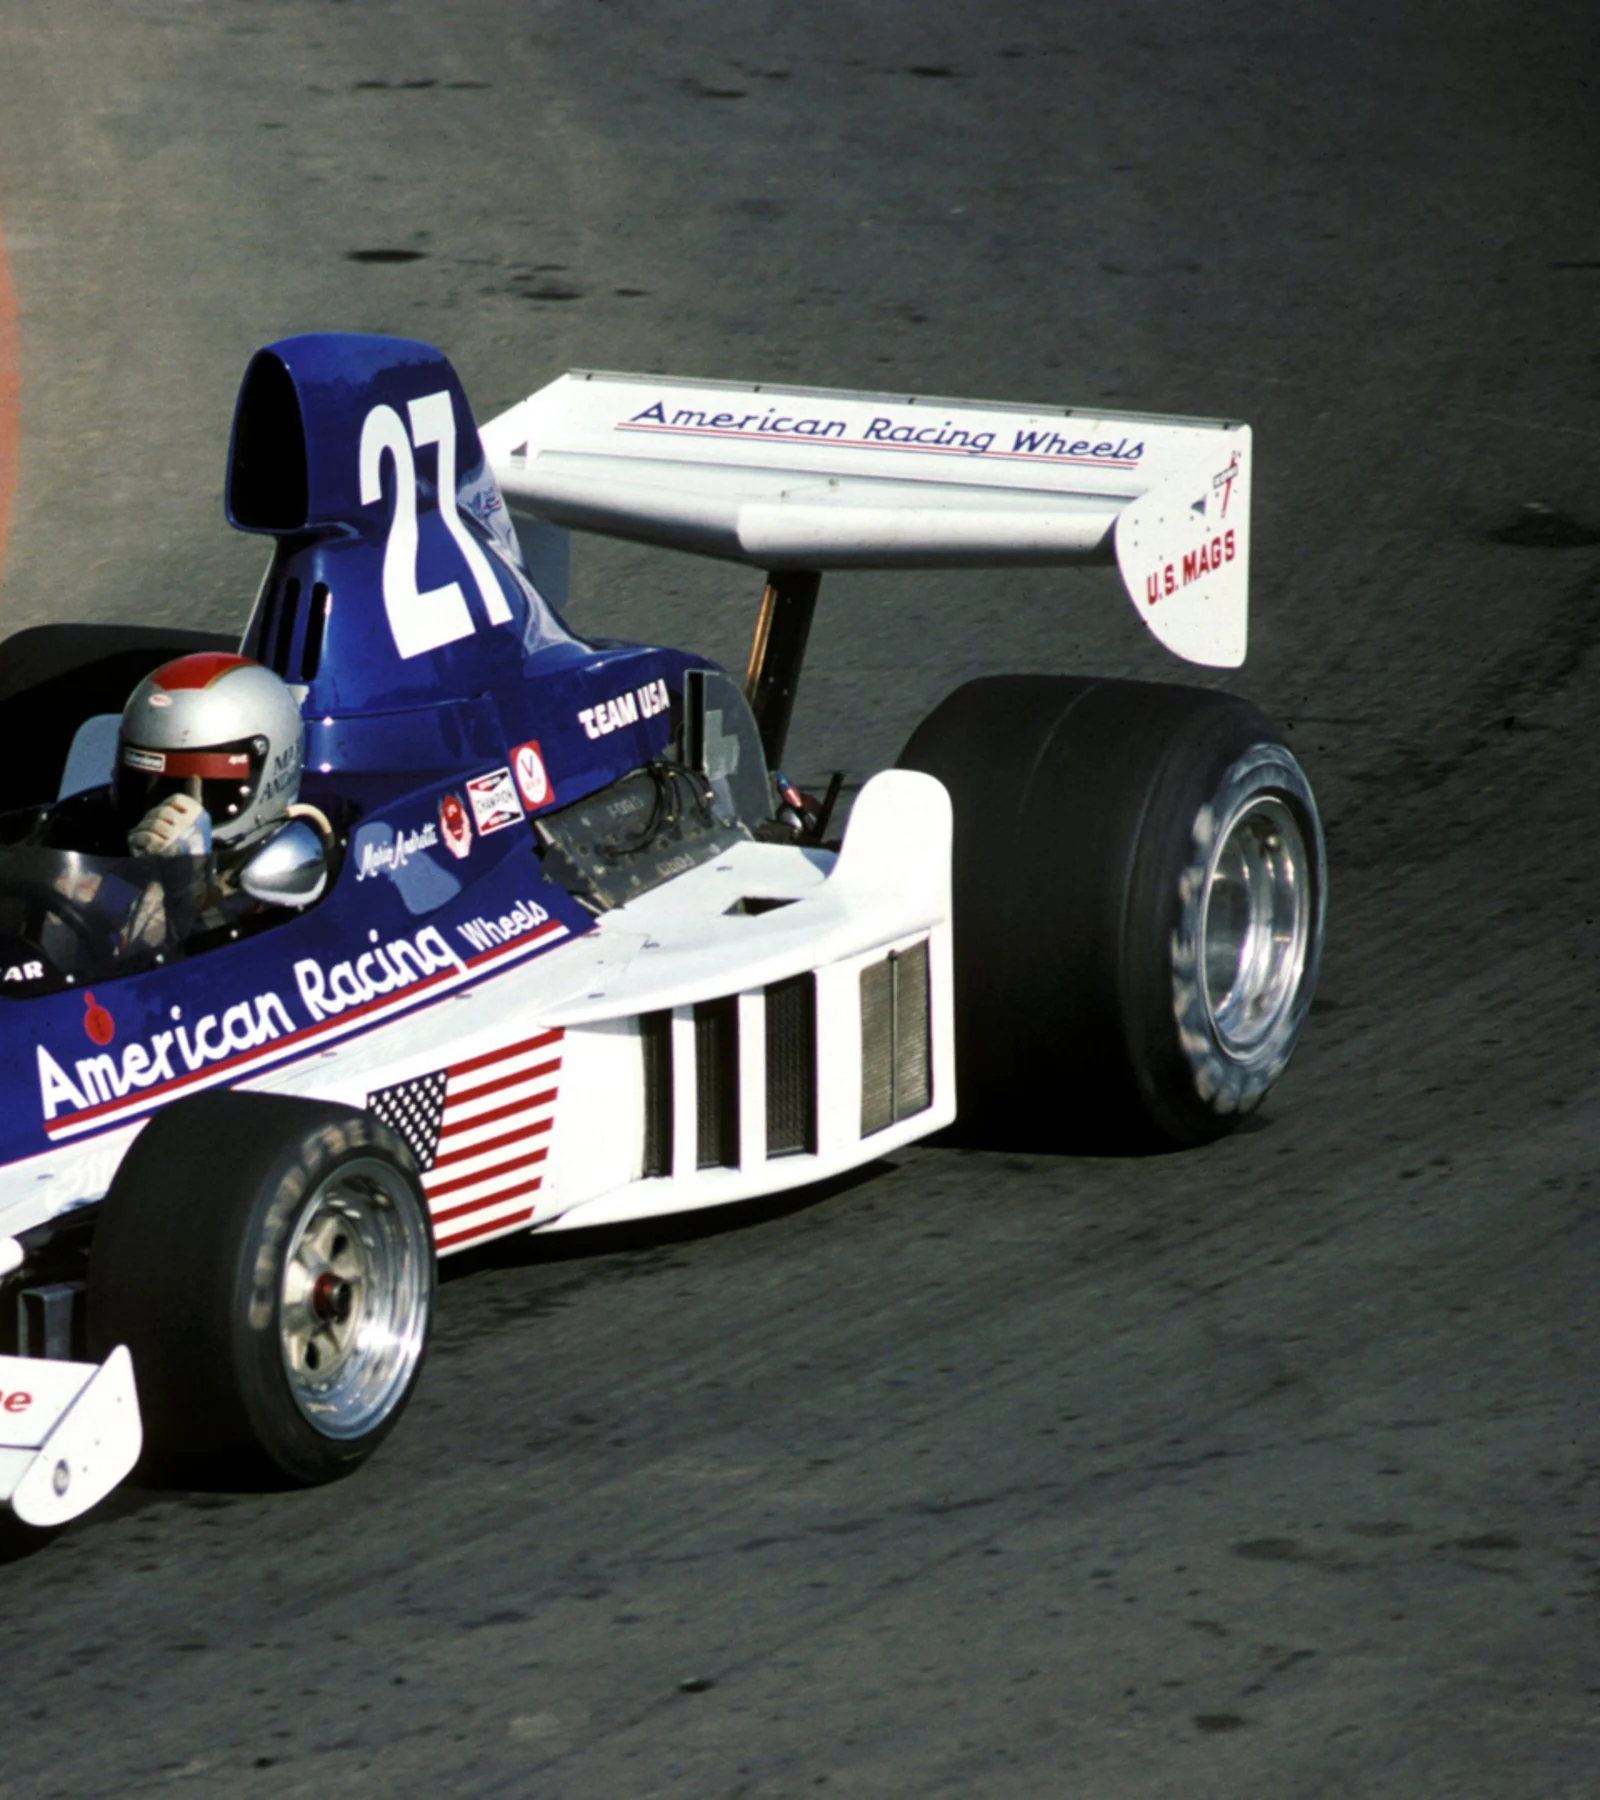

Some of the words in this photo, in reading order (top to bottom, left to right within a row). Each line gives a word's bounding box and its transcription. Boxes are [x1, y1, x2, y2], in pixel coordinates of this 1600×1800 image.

[629, 400, 848, 438] American
[862, 417, 997, 455] Racing
[1011, 429, 1146, 460] Wheels
[359, 390, 514, 660] 27
[1146, 563, 1180, 606] U.S.
[1183, 529, 1236, 587] MAGS
[578, 691, 639, 740] TEAM
[637, 677, 671, 719] USA
[36, 991, 298, 1121] American
[293, 925, 467, 1024] Racing
[457, 898, 550, 953] Wheels
